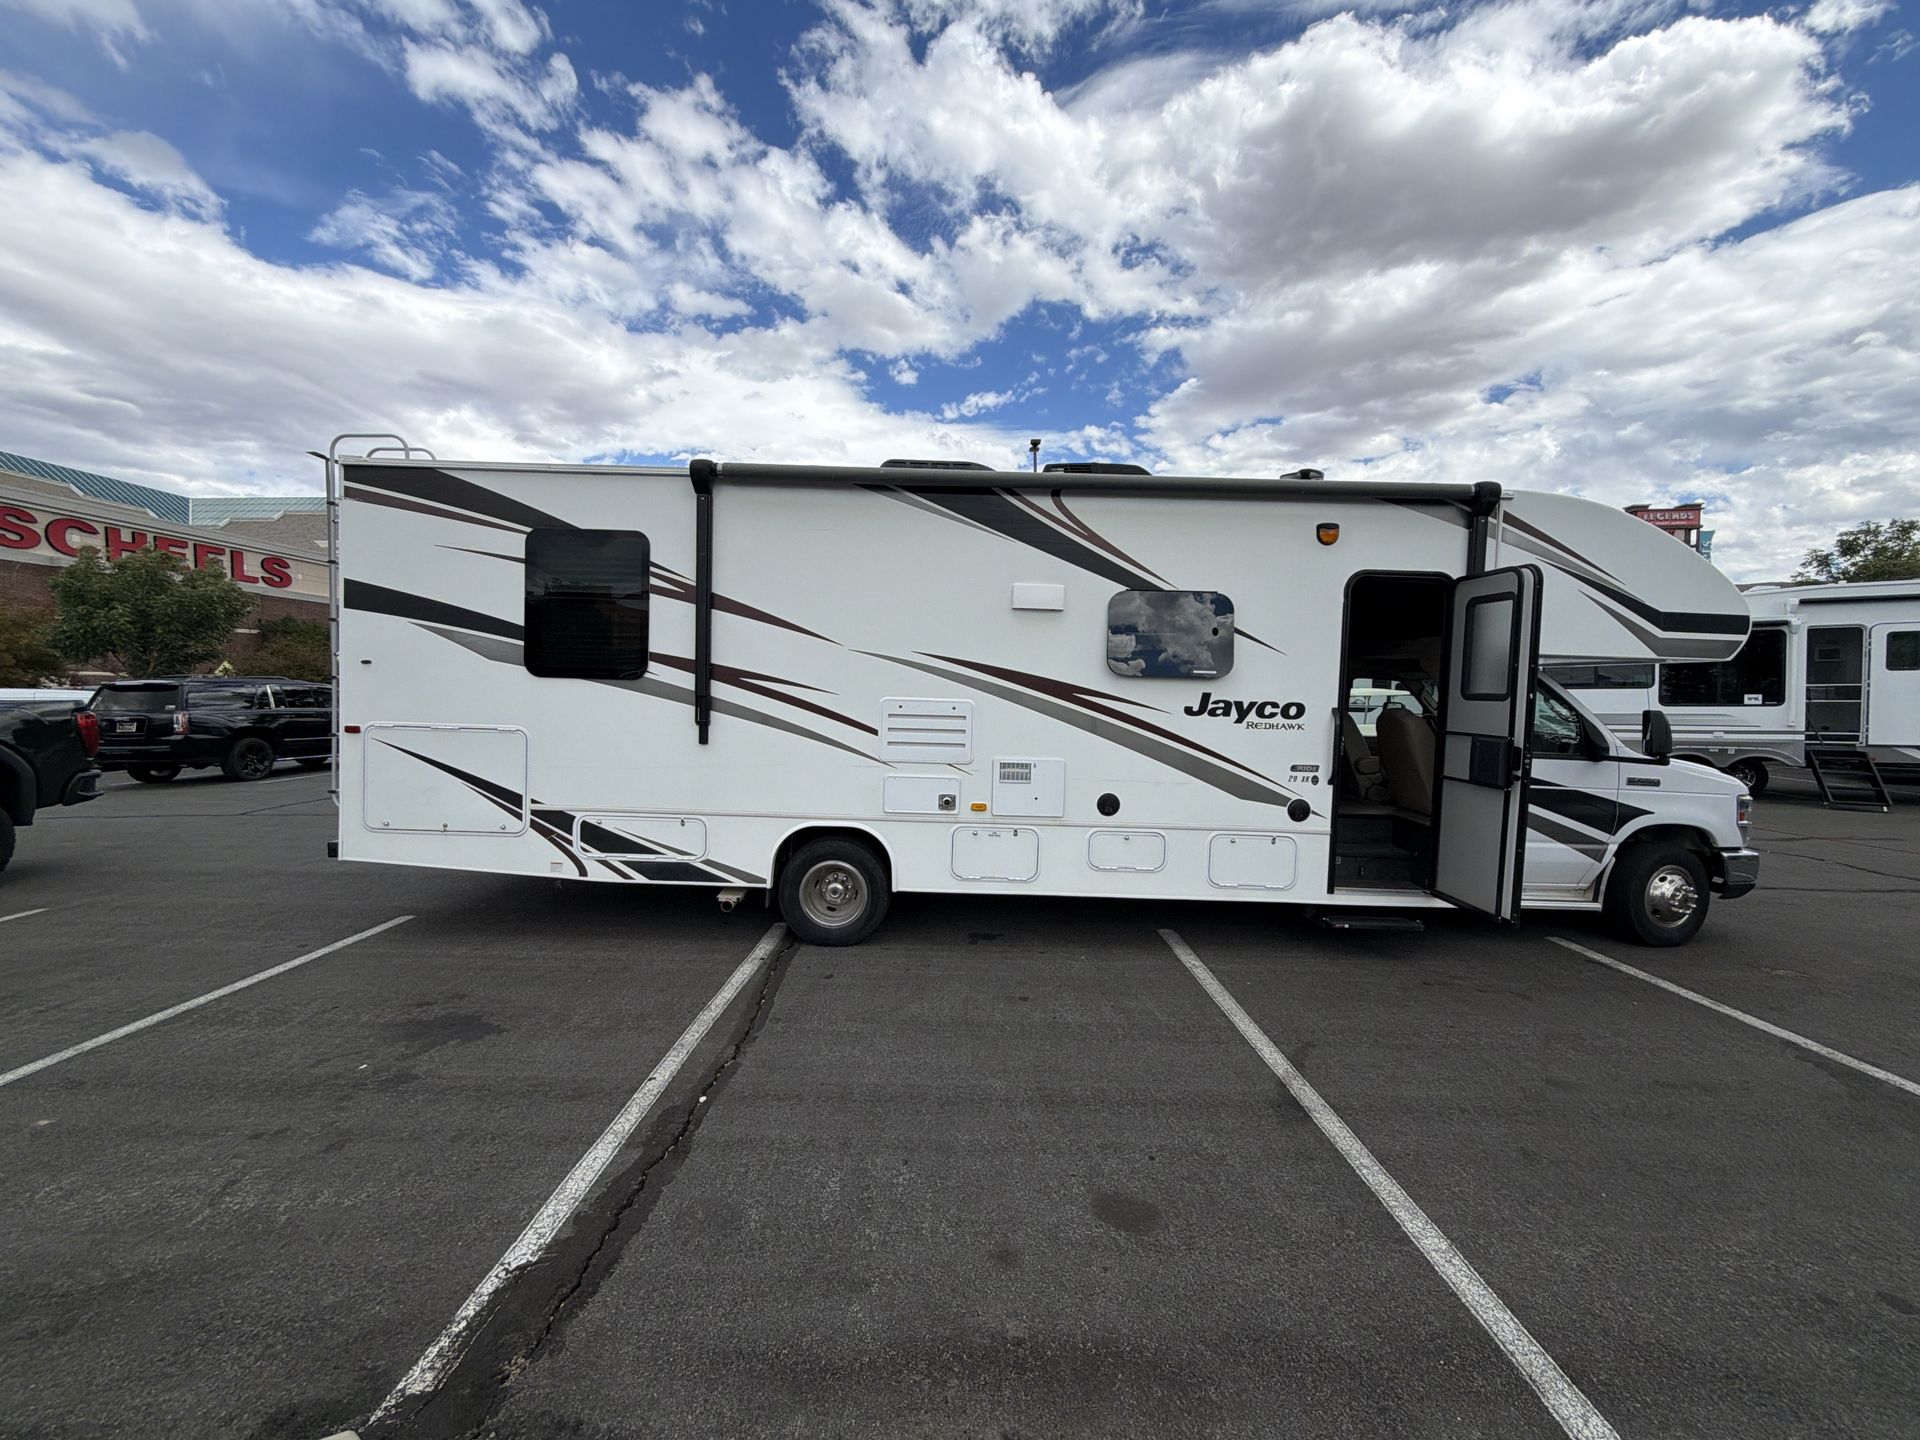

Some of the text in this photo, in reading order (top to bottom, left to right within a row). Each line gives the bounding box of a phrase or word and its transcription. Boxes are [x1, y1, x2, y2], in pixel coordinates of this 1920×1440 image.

[1643, 511, 1694, 520] LEGENDS
[1184, 692, 1306, 724] Jayco
[1245, 721, 1305, 731] REDHAWK
